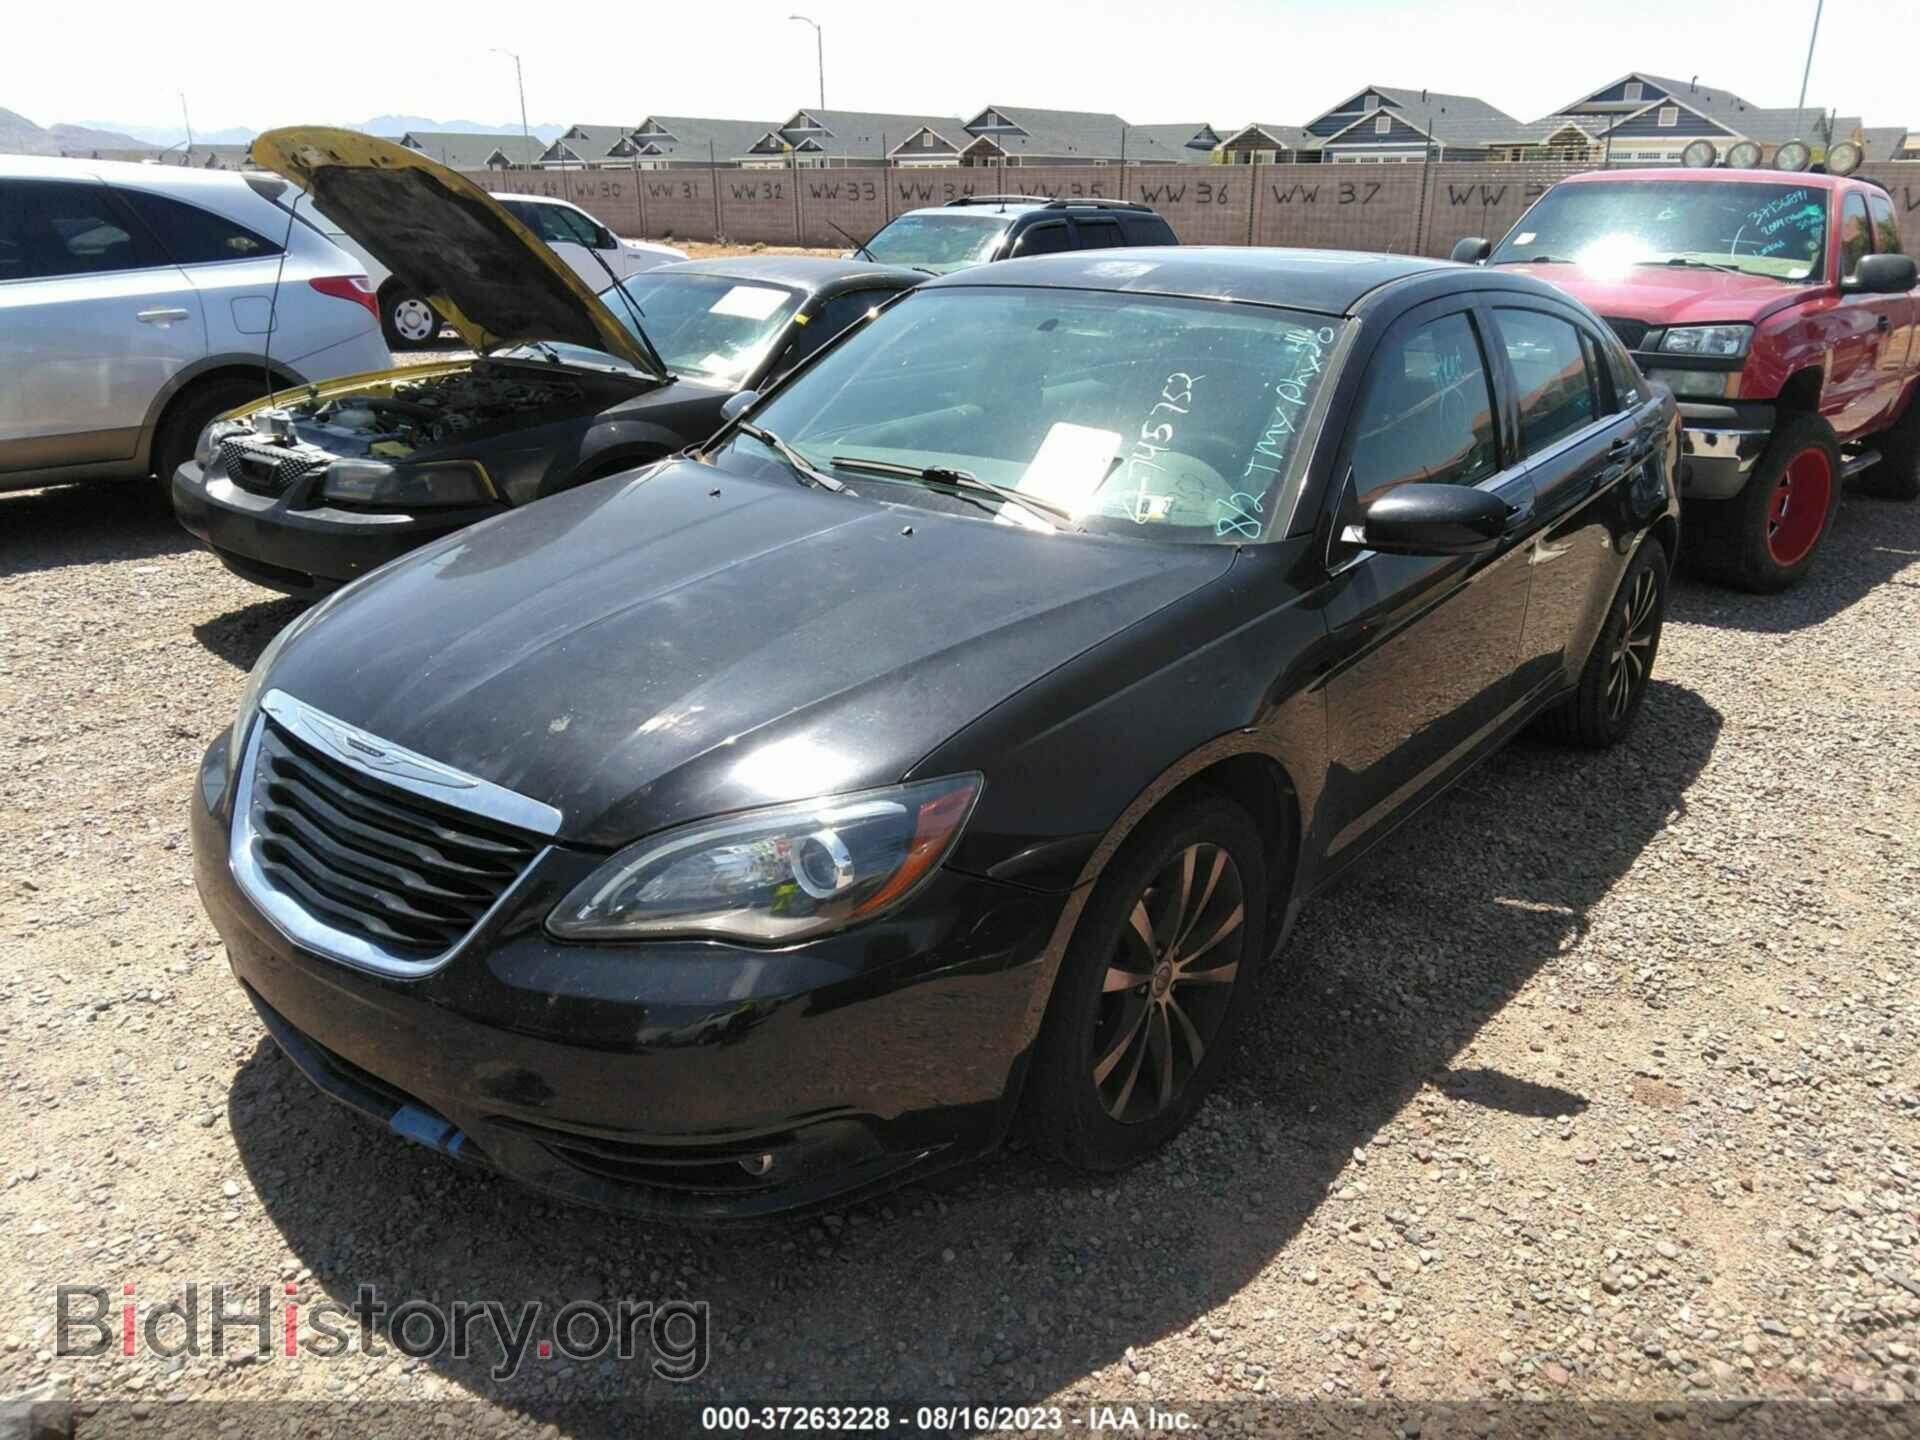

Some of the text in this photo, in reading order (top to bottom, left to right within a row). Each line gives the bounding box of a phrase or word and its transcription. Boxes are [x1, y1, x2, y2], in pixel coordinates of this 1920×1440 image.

[575, 183, 621, 199] WW 30
[649, 183, 699, 199] WW 31
[731, 183, 783, 200] WW 32
[810, 182, 876, 201] WW 33
[899, 182, 975, 201] WW 34
[1019, 183, 1061, 201] WW
[1140, 183, 1229, 204] WW 36
[1272, 182, 1382, 205] WW 37
[1448, 184, 1508, 206] WW
